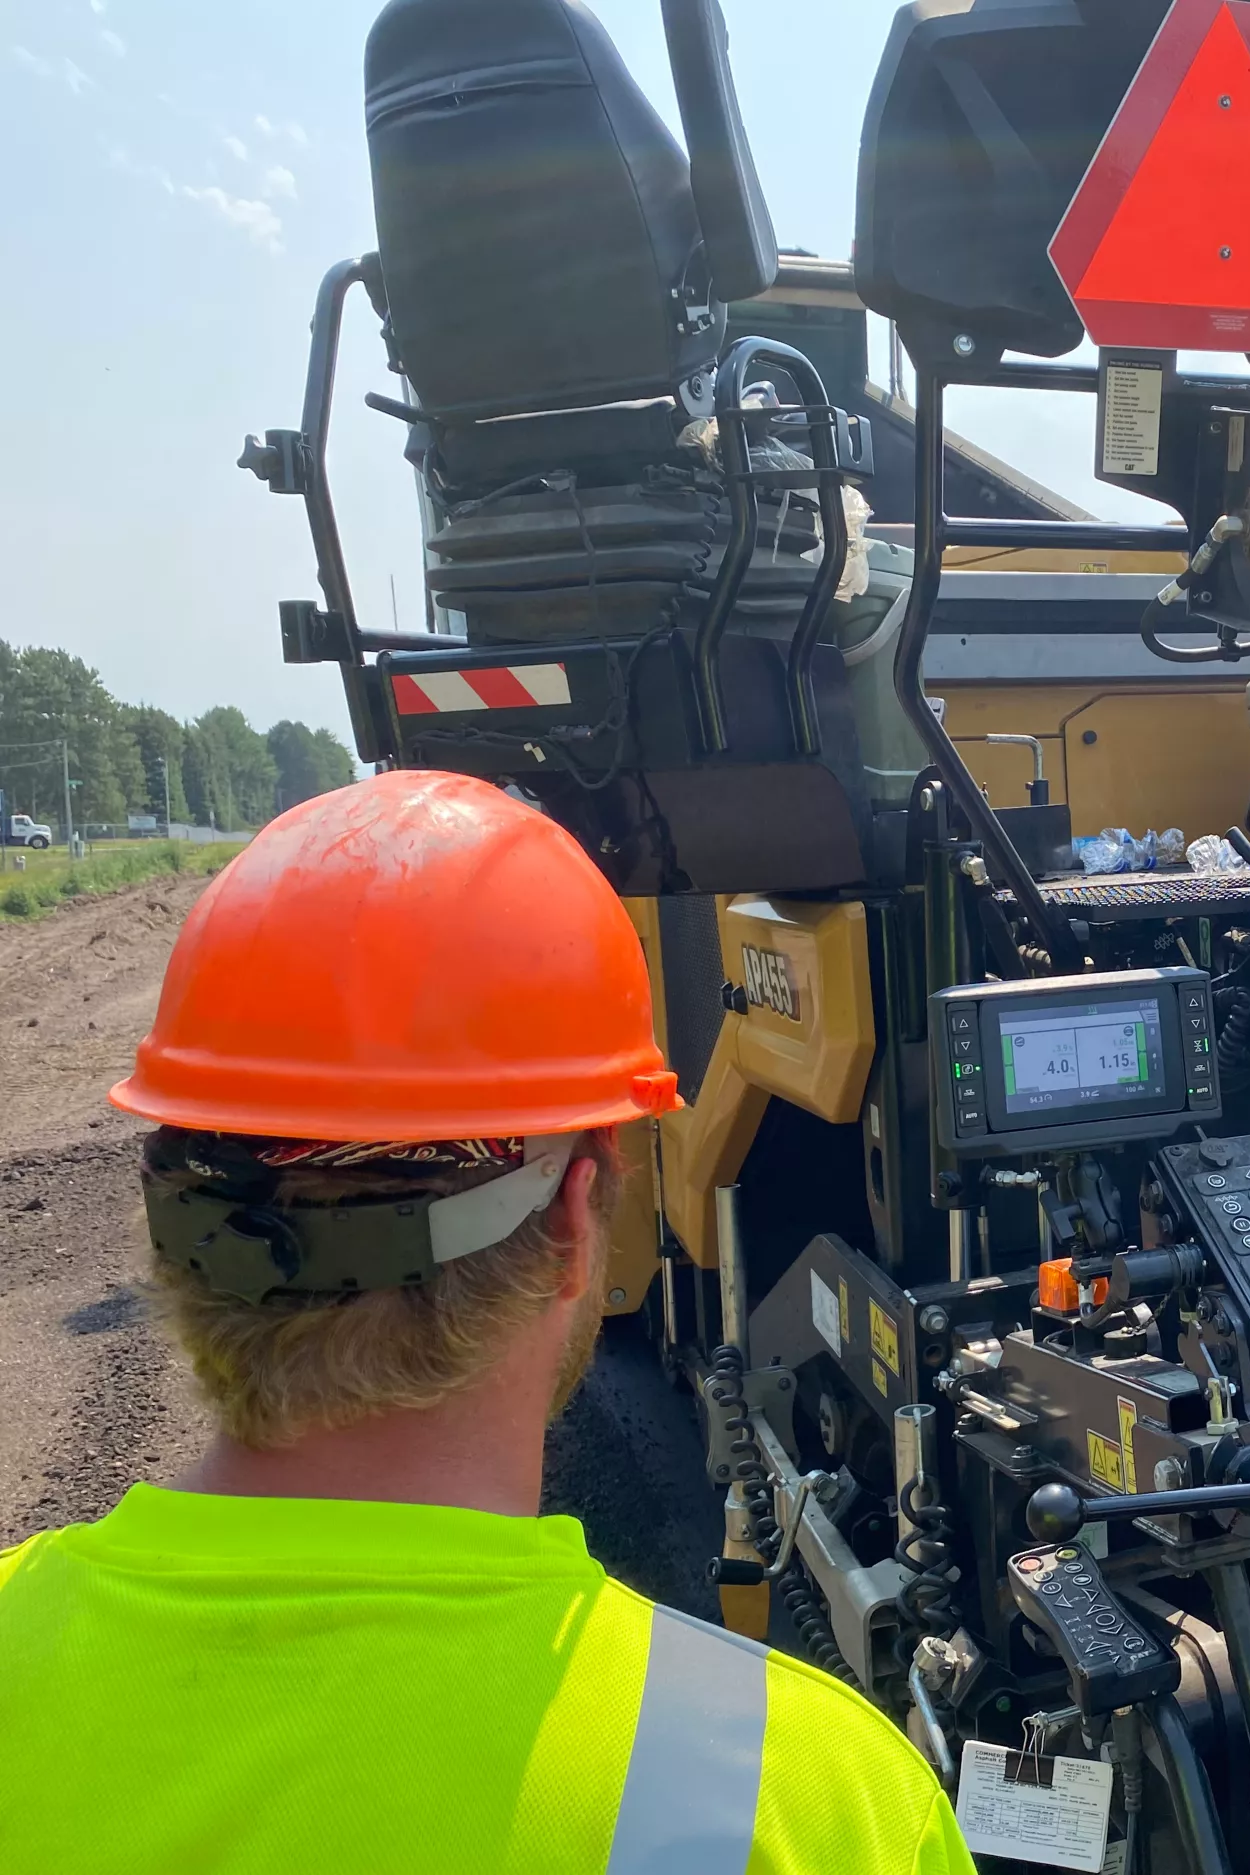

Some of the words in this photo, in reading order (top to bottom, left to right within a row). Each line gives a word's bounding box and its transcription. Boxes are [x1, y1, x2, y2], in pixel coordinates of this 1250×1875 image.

[742, 947, 793, 1015] AP455
[1047, 1059, 1069, 1075] 4.0
[1099, 1053, 1130, 1069] 1.15
